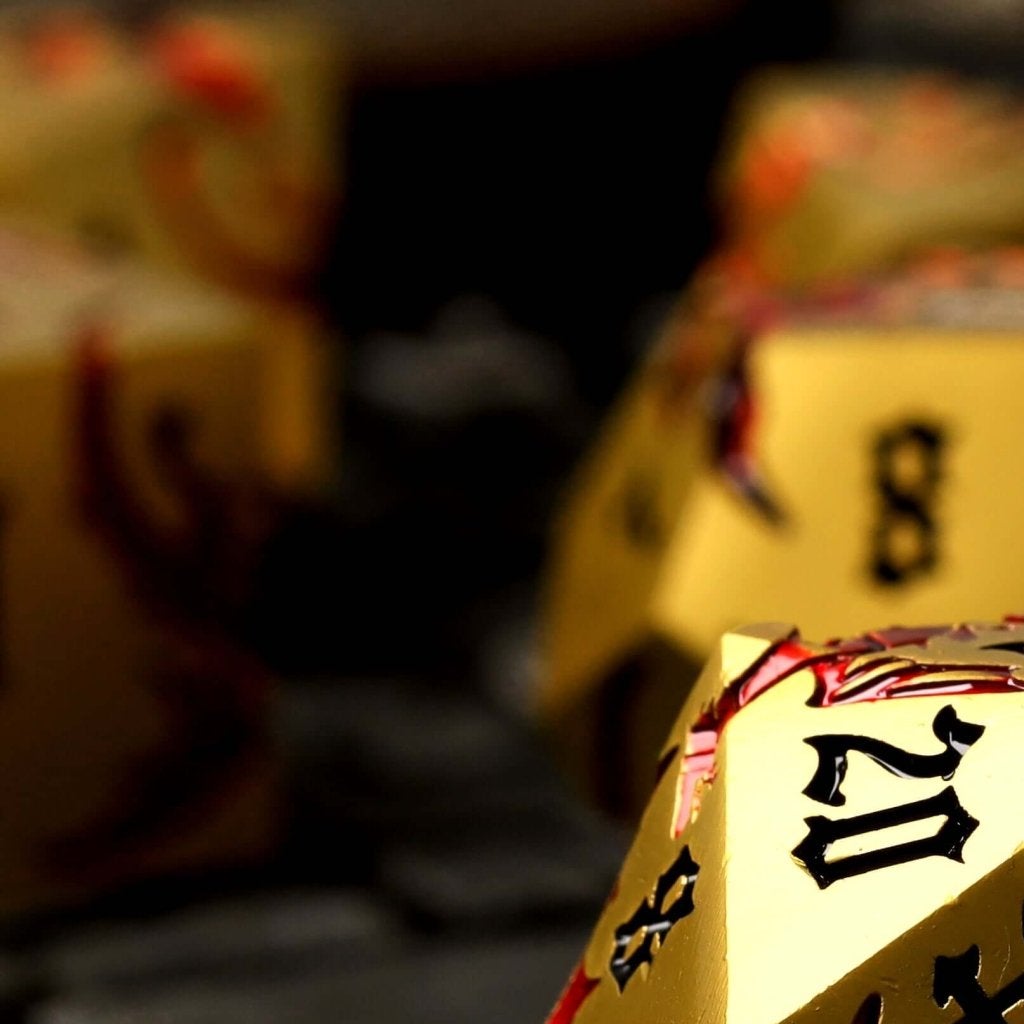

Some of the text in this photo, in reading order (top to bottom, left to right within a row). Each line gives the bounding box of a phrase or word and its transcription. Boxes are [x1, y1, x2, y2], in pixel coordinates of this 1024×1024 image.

[868, 420, 949, 584] 8
[791, 705, 984, 888] 20
[611, 846, 700, 992] 8
